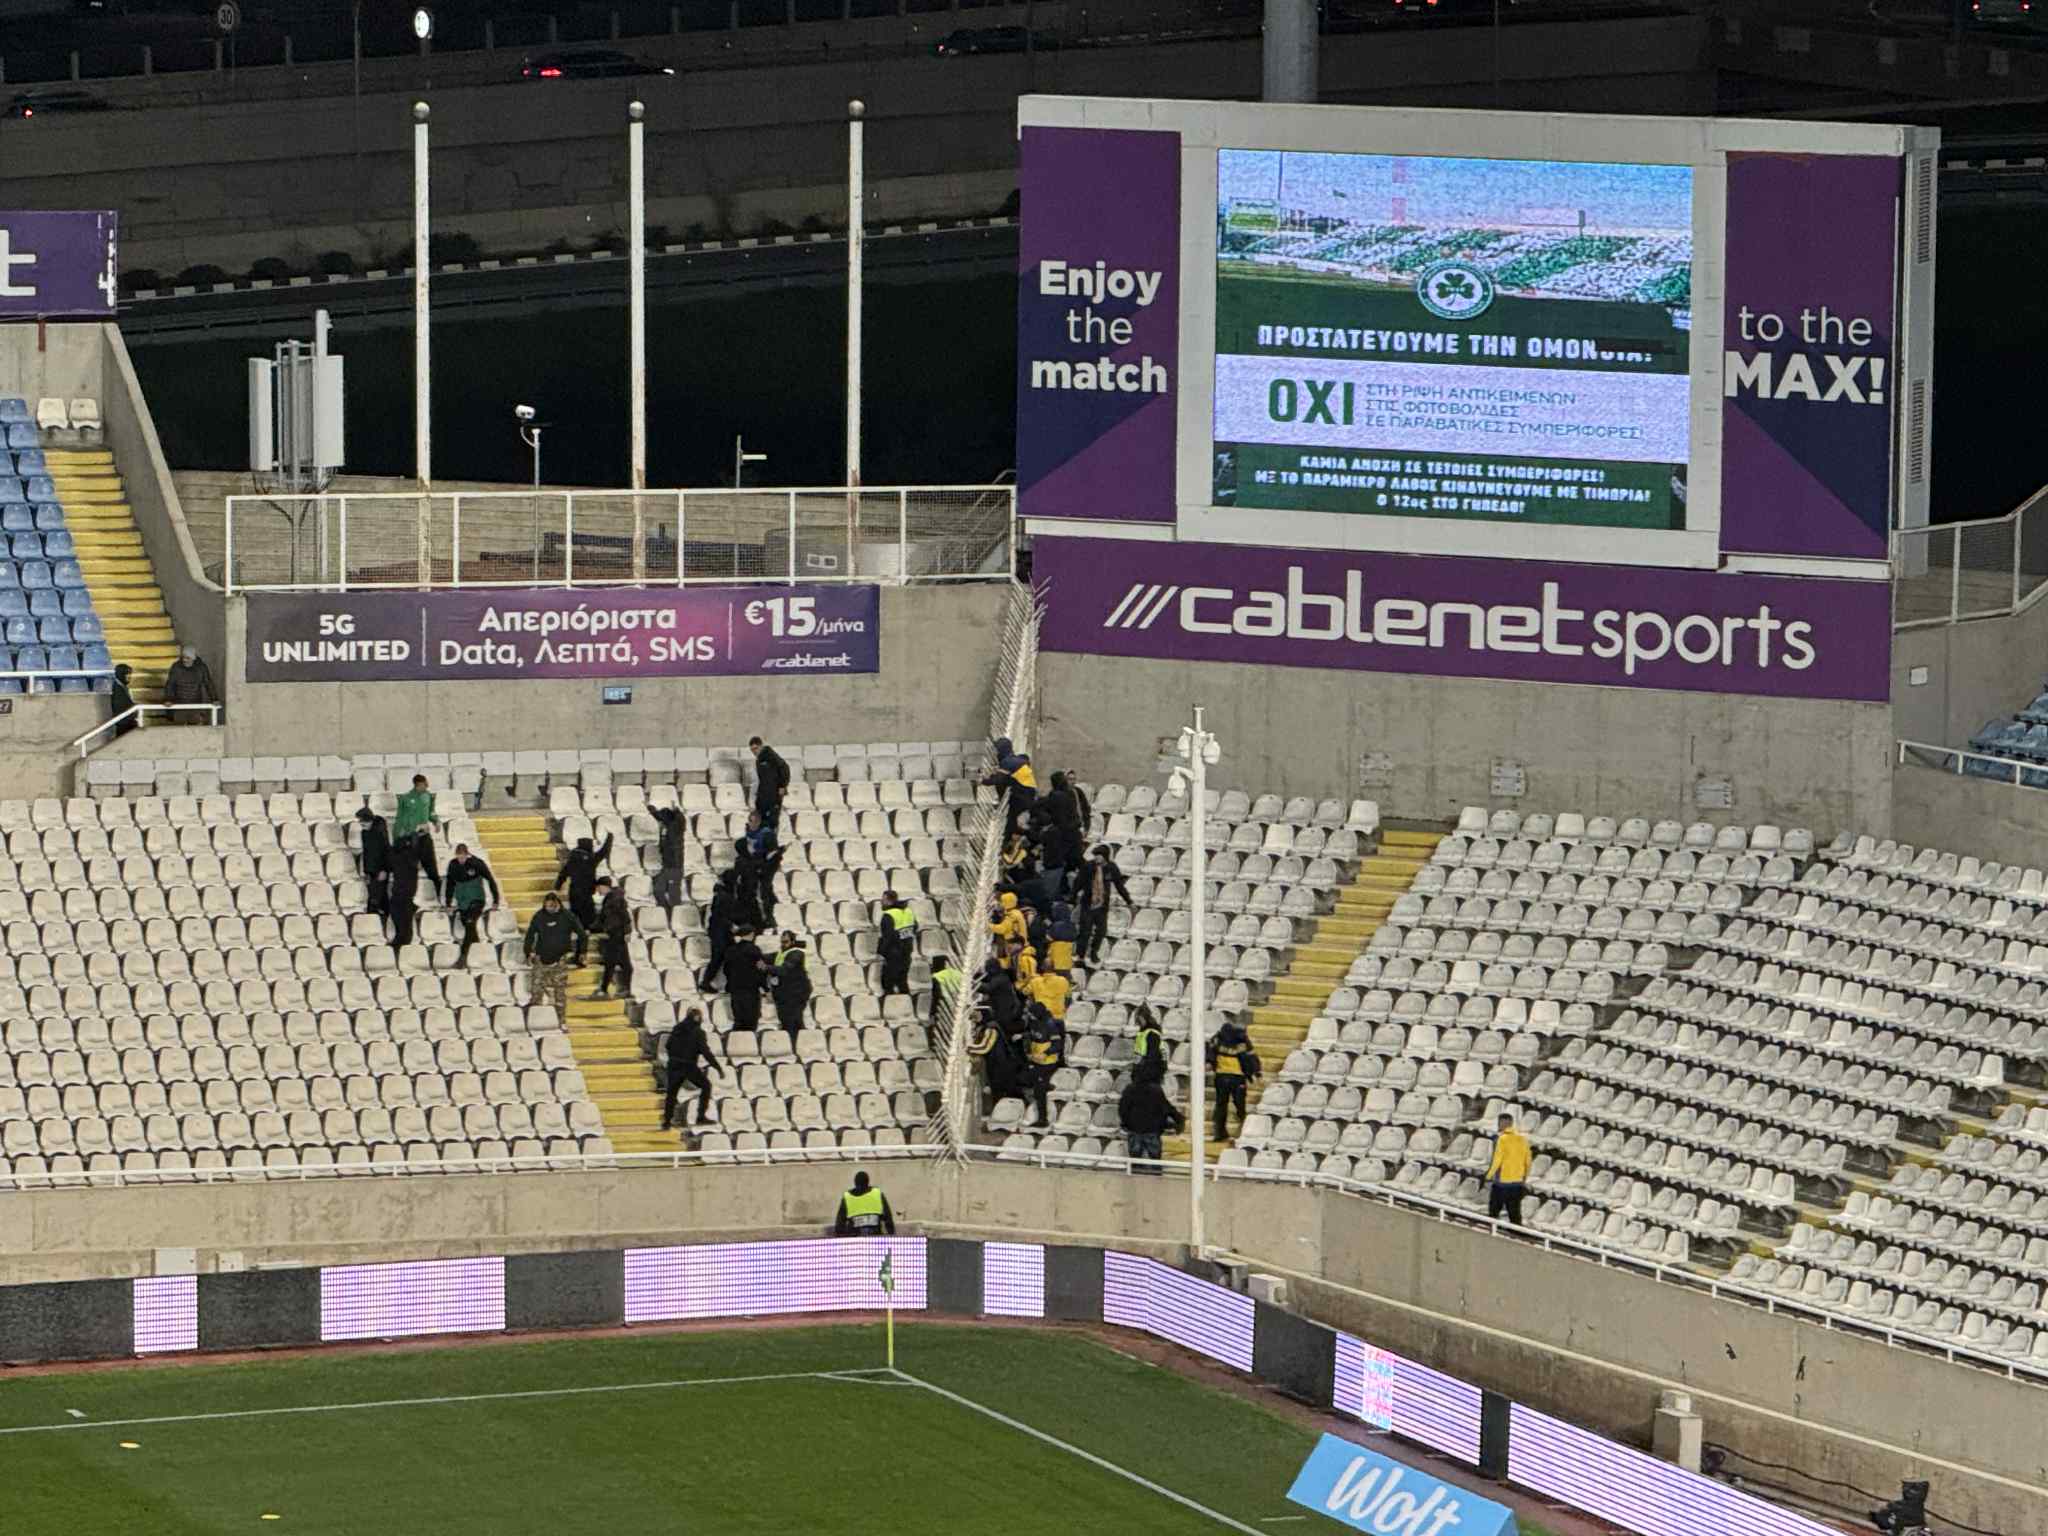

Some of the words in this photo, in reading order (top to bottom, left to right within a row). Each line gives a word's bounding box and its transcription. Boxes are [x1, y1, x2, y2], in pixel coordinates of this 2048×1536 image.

[1040, 260, 1162, 306] Enjoy
[1066, 307, 1133, 344] the
[1258, 325, 1459, 353] ΠΡΟΣΤΑΤΕΥΟΥΜΕ
[1469, 335, 1517, 356] ΤΗΝ
[1739, 305, 1784, 341] to
[1801, 306, 1872, 346] the
[1032, 355, 1167, 392] match
[1725, 351, 1884, 404] MAX!
[1268, 378, 1354, 425] ΟΧΙ
[1366, 384, 1396, 396] ΣΤΗ
[1402, 385, 1443, 398] ΡΙΨΗ
[1449, 388, 1576, 404] ΑΝΤΙΚΕΙΜΕΝΩΝ
[1403, 401, 1520, 417] ΦΩΤΟΒΟΛΙΔΕΣ
[1366, 415, 1385, 427] ΣΕ
[1390, 416, 1504, 433] ΠΑΡΑΒΑΤΙΚΕΣ
[1300, 456, 1347, 470] ΚΑΜΙΑ
[1405, 460, 1422, 474] ΣΕ
[319, 614, 355, 635] 5G
[478, 603, 677, 636] Απεριόριστα
[263, 640, 410, 662] UNLIMITED
[440, 638, 524, 667] Data,
[534, 635, 639, 666] Λεπτά,
[649, 636, 715, 661] SMS
[1326, 1456, 1461, 1536] Wolt
